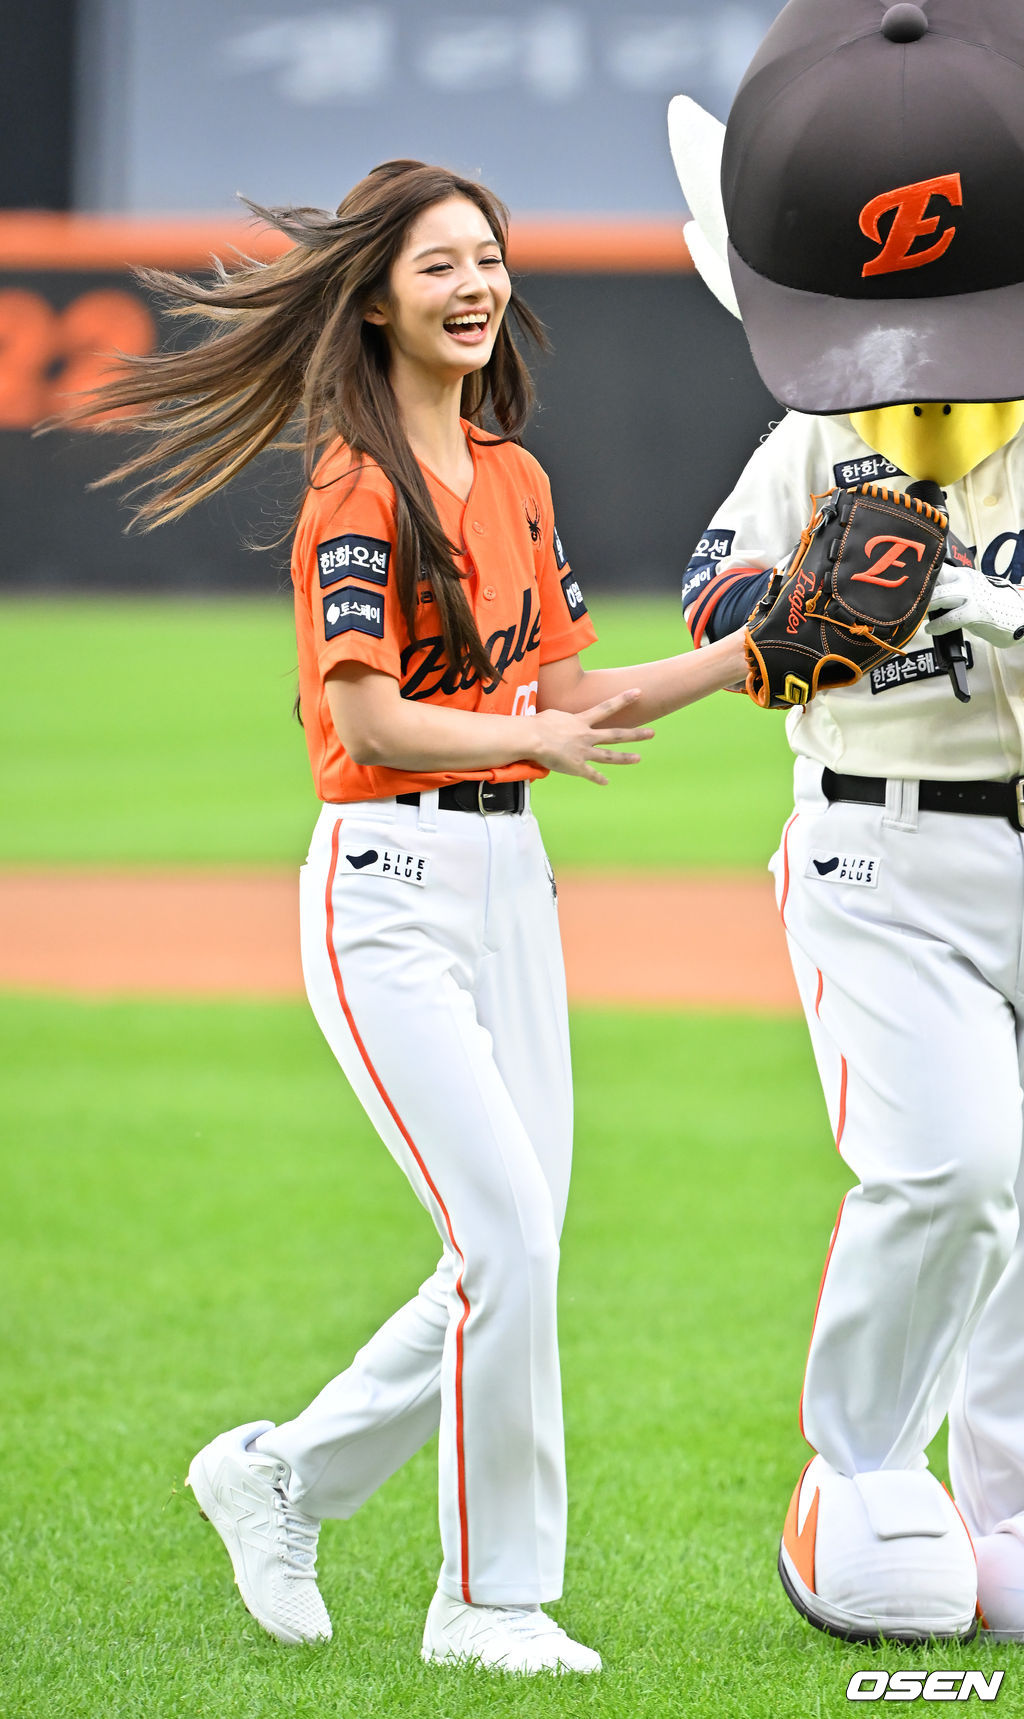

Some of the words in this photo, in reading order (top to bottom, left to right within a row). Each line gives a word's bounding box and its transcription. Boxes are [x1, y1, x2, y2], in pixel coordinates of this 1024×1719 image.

[859, 172, 963, 278] E
[319, 544, 387, 575] 한화오션
[691, 538, 729, 561] 오션
[850, 535, 926, 588] E
[340, 601, 381, 624] 토스페이
[786, 569, 816, 635] Eagles
[872, 652, 940, 689] 한화손해
[382, 863, 423, 881] PLUS
[384, 851, 425, 870] LIFE
[842, 857, 875, 871] LIFE
[840, 869, 872, 883] PLUS
